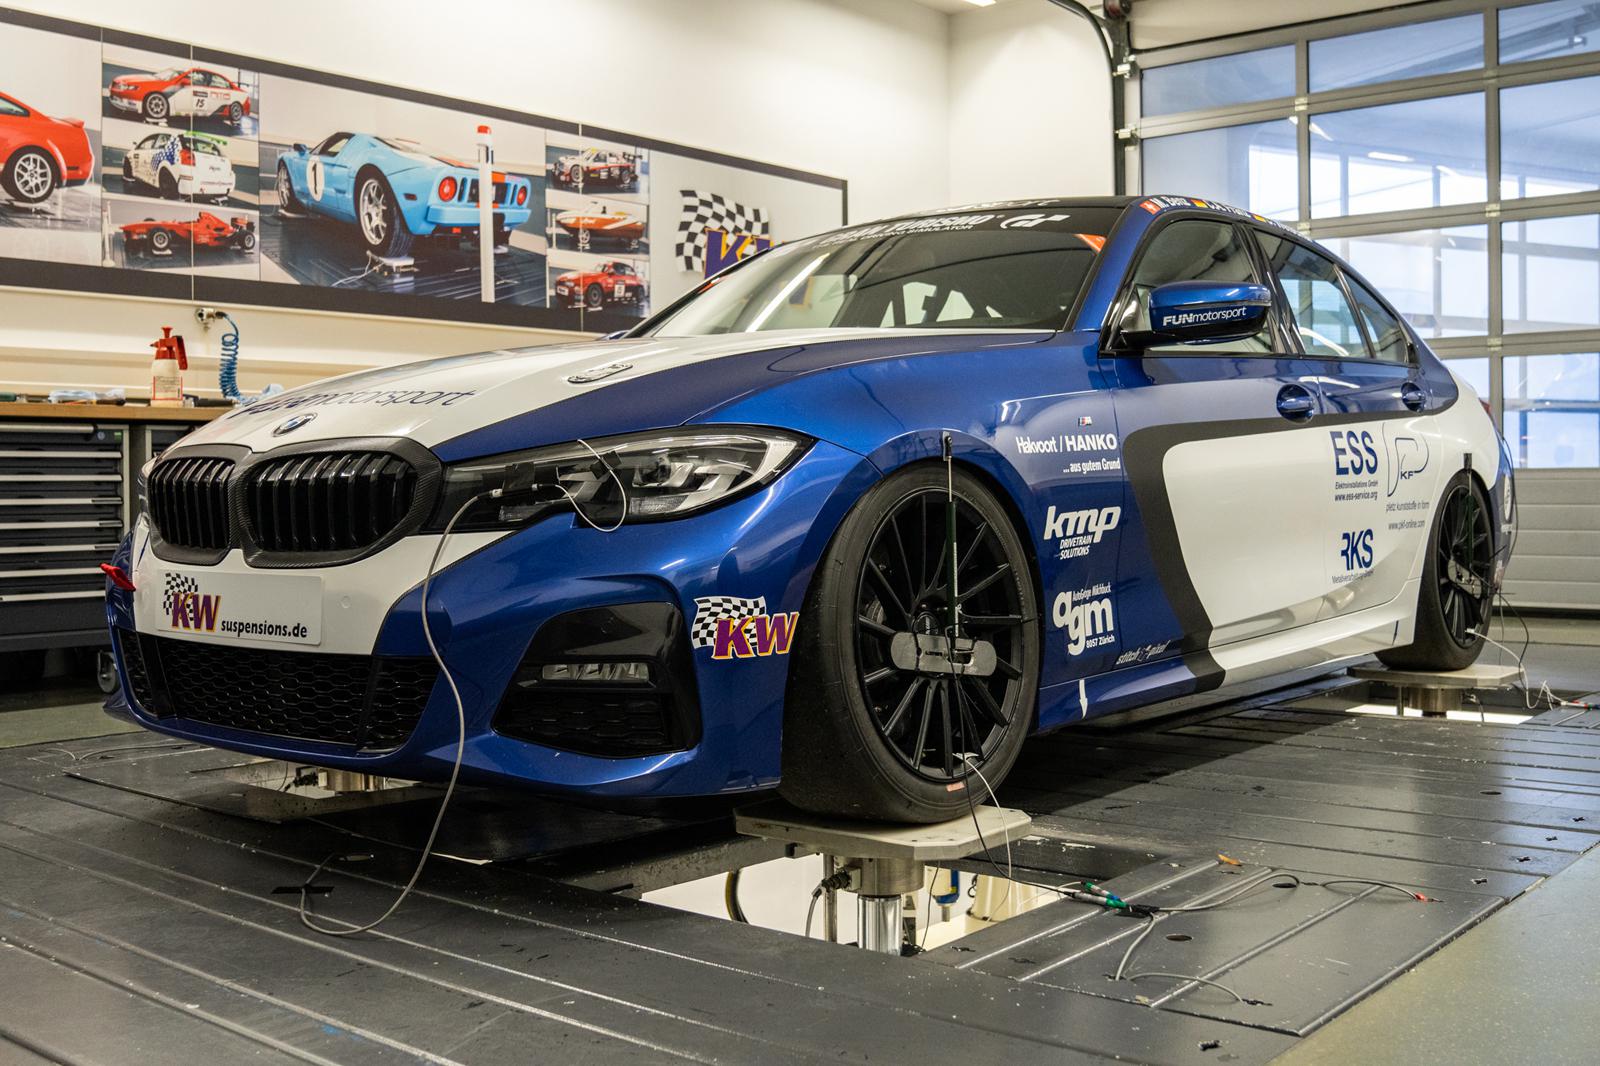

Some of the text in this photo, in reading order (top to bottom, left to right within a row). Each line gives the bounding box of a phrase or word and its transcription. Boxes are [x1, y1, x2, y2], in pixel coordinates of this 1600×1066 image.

[1162, 307, 1247, 326] FUNmotorsport
[1016, 436, 1058, 454] Hakvoort
[1065, 433, 1117, 451] HANKO
[1330, 430, 1378, 475] ESS
[1082, 459, 1101, 474] gutem
[1101, 457, 1121, 470] Grund
[1044, 505, 1121, 543] kmp
[1060, 535, 1093, 549] DRIVETRAIN
[1060, 545, 1091, 560] SOLUTIONS
[1340, 529, 1374, 571] RKS
[172, 591, 307, 638] KW suspensions.de
[1053, 590, 1114, 656] agm
[711, 611, 800, 660] KW
